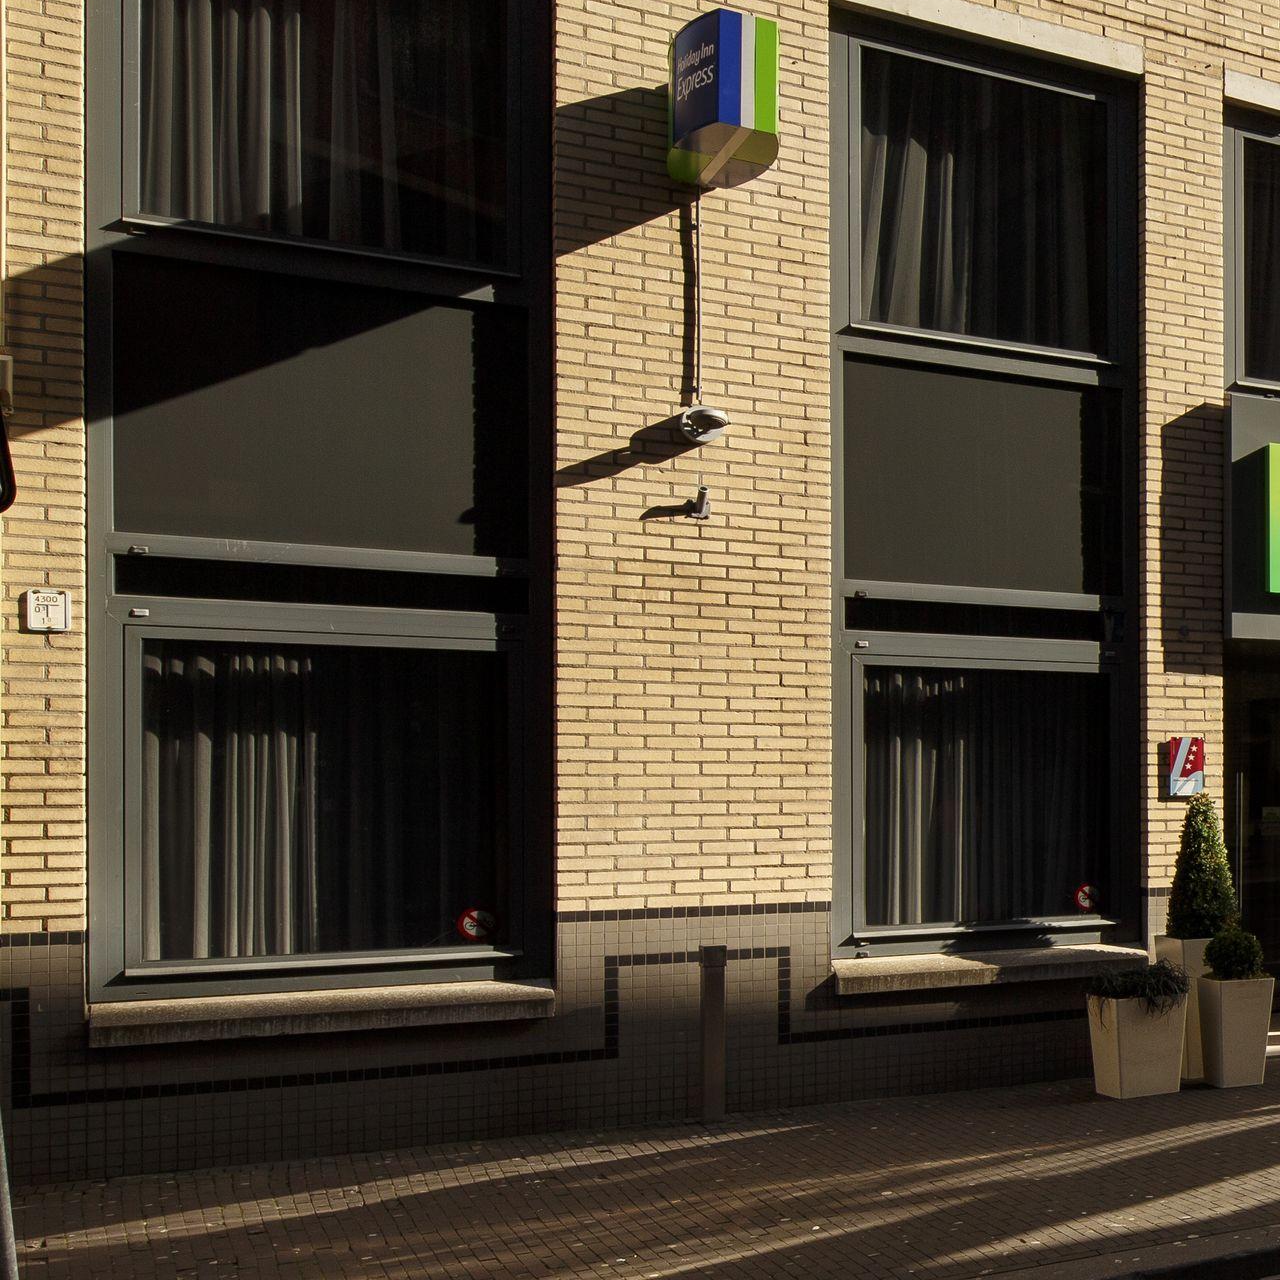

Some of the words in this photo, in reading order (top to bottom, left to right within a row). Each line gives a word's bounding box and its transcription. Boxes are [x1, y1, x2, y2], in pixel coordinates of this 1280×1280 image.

[677, 50, 701, 74] Holiday
[701, 42, 714, 59] Inn
[677, 65, 714, 101] Express
[35, 595, 58, 603] 4300
